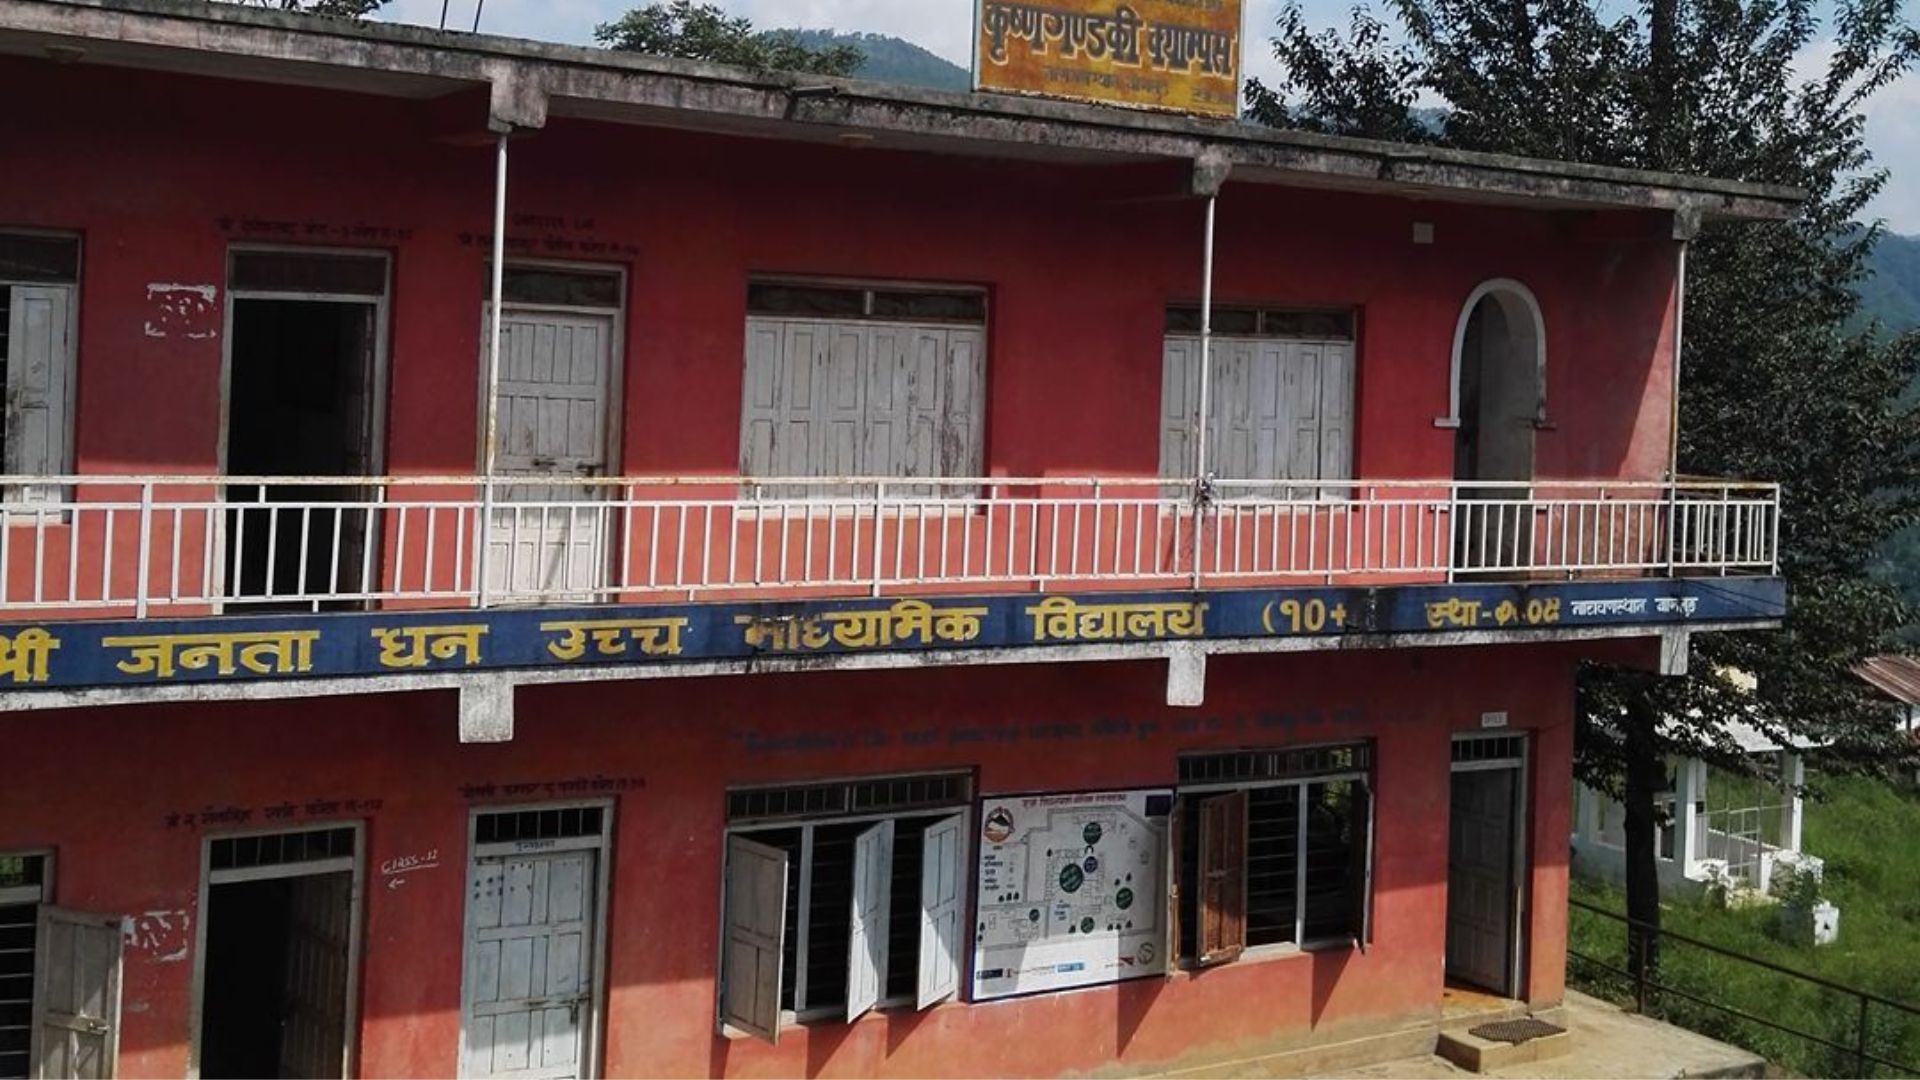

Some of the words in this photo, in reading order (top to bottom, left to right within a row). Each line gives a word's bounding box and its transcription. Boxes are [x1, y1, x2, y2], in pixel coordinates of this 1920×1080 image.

[102, 630, 320, 677] जनता
[371, 624, 489, 667] धन
[540, 617, 688, 660] उच्च
[1025, 596, 1209, 640] विद्यालय
